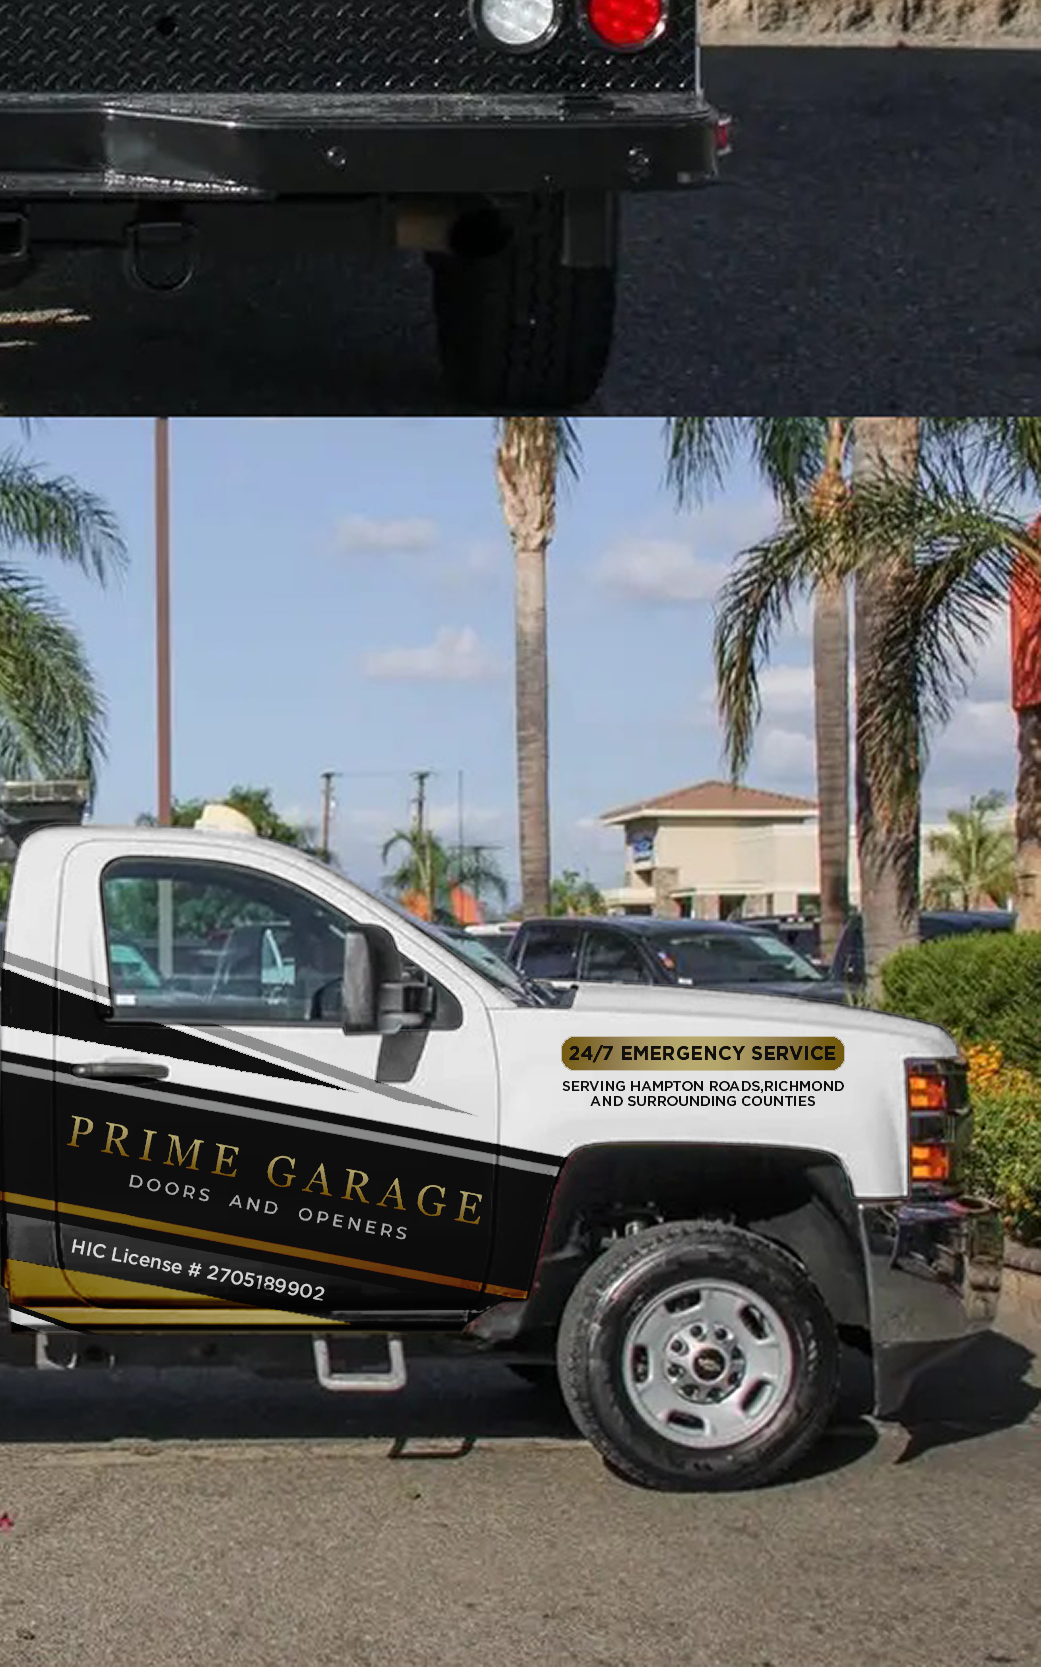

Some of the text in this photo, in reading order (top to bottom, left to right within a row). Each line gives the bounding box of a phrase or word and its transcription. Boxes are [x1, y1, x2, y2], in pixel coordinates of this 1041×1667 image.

[569, 1045, 835, 1062] 24/7 EMERGENCY SERVICE
[563, 1081, 625, 1091] SERVING
[631, 1081, 703, 1091] HAMPTON
[591, 1096, 815, 1106] AND SURROUNDING COUNTIES
[68, 1115, 483, 1225] PRIME GARAGE
[129, 1175, 407, 1239] DOORS AND OPENERS
[72, 1239, 325, 1301] HIC License # 2705189902
